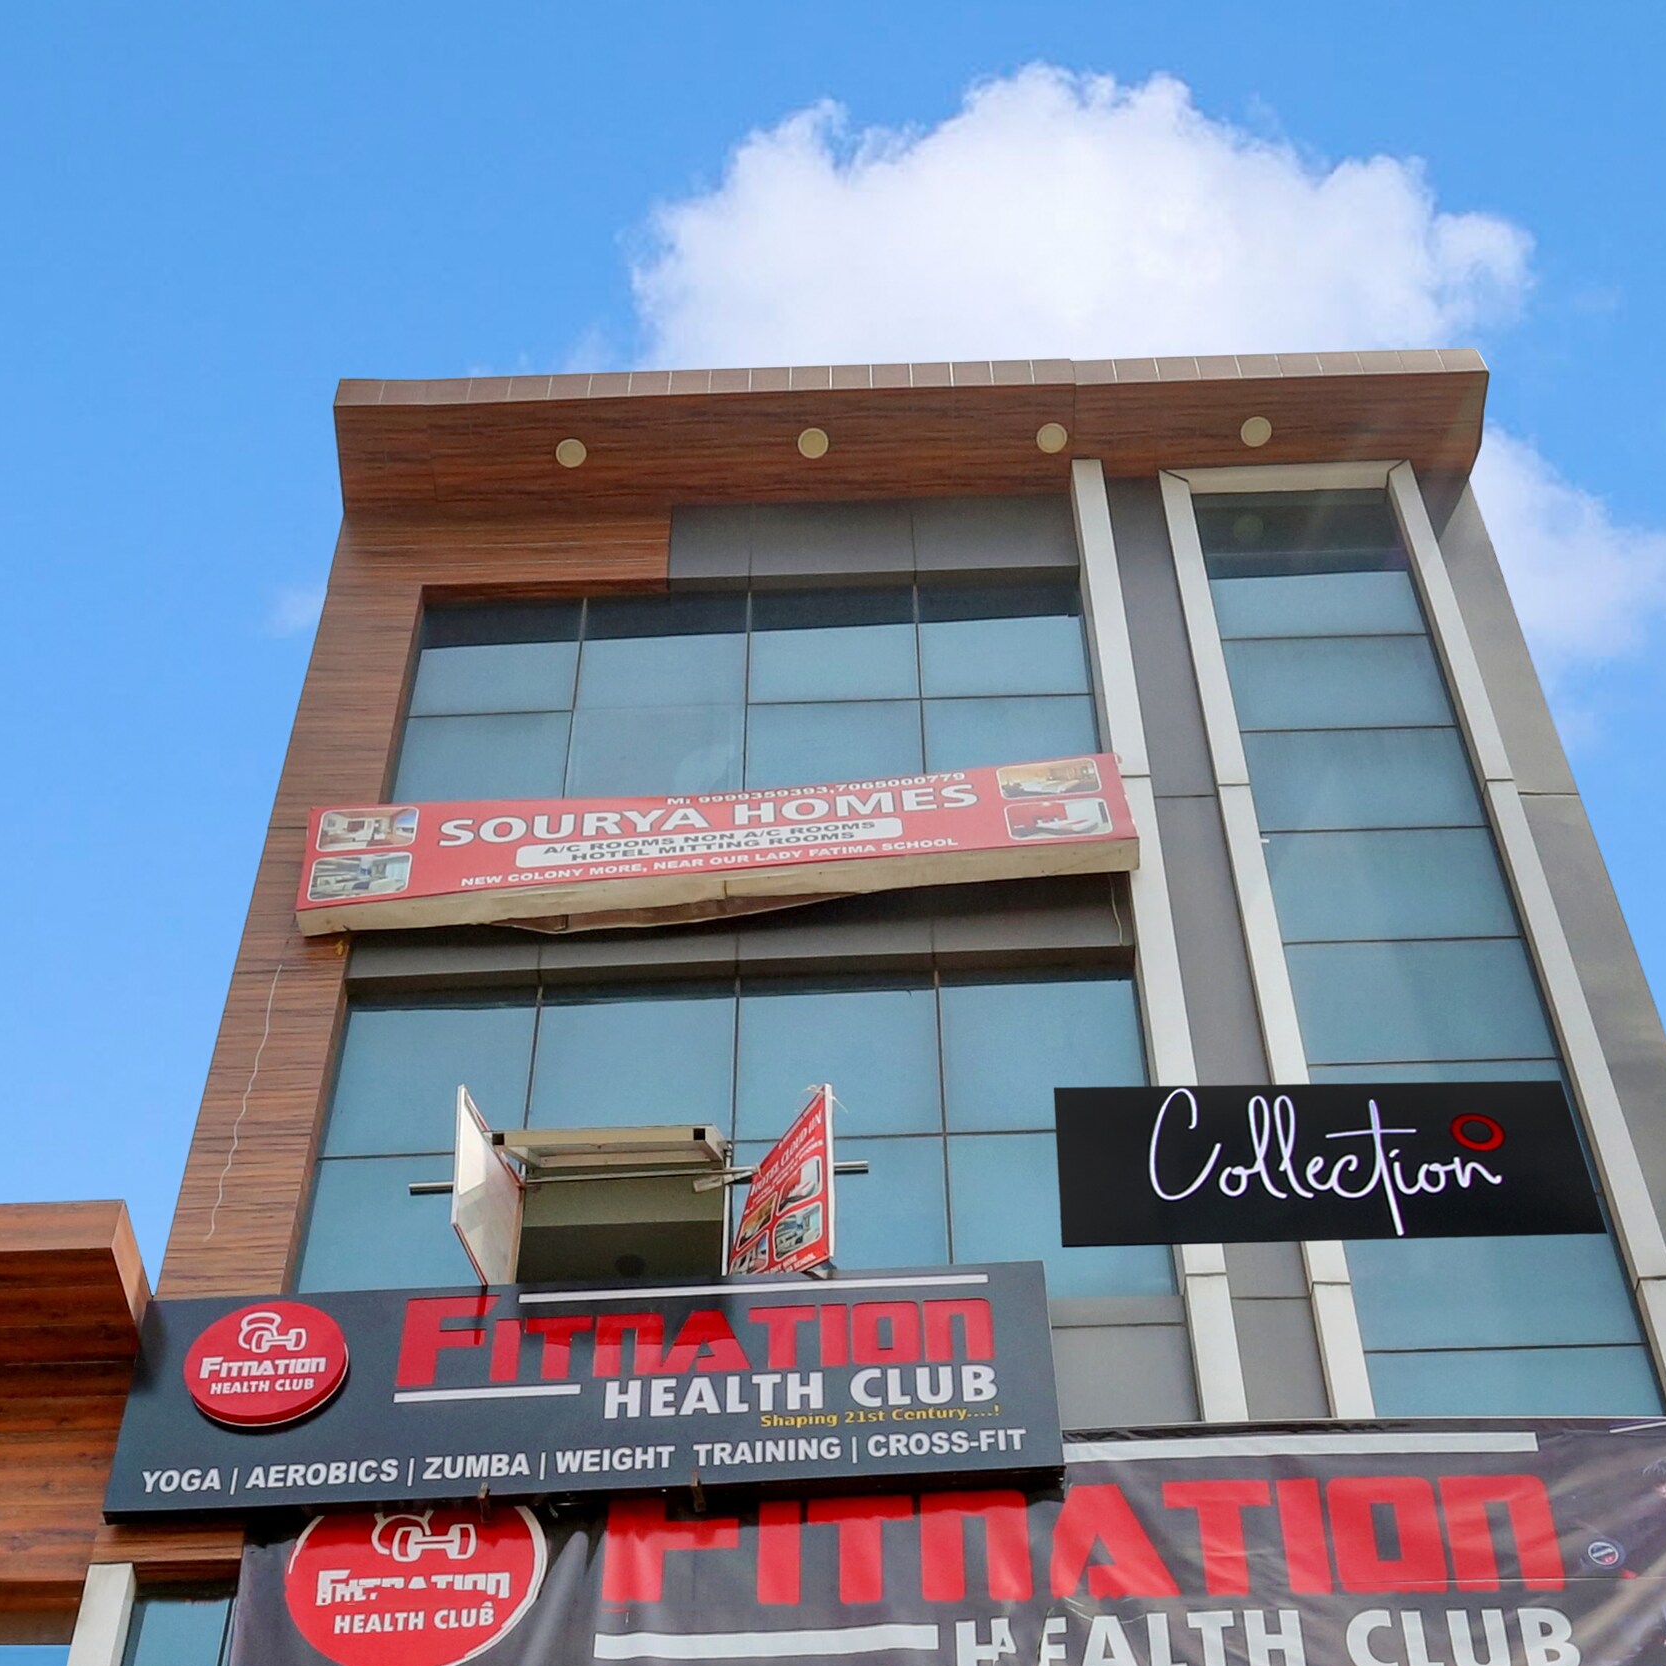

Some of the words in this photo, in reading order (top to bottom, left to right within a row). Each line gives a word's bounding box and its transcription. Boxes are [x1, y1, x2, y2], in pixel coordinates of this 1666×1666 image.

[438, 806, 711, 847] SOURYA
[732, 783, 978, 826] HOMES
[543, 842, 581, 855] A/C
[589, 836, 675, 851] ROOMS
[682, 832, 742, 846] NON
[744, 827, 782, 839] A/C
[789, 820, 876, 836] ROOMS
[571, 848, 651, 862] HOTEL
[657, 838, 761, 856] MITTING
[768, 830, 854, 847] ROOMS
[460, 874, 503, 887] NEW
[507, 867, 583, 883] COLONY
[653, 856, 704, 871] NEAR
[709, 853, 749, 865] OUR
[754, 849, 802, 862] LADY
[808, 843, 877, 858] FATIMA
[881, 837, 959, 852] SCHOOL
[1149, 1087, 1503, 1236] Collection
[209, 1380, 270, 1395] HEALTH
[275, 1376, 315, 1391] CLUB
[603, 1371, 823, 1419] HEALTH
[849, 1363, 998, 1408] CLUB
[760, 1412, 839, 1428] Shaping
[843, 1408, 886, 1423] 21st
[141, 1467, 222, 1494] YOGA
[244, 1457, 399, 1489] AEROBICS
[421, 1451, 531, 1481] ZUMBA
[555, 1444, 676, 1475] WEIGHT
[693, 1436, 842, 1467] TRAINING
[866, 1428, 1027, 1458] CROSS-FIT
[333, 1611, 426, 1635] HEALTH
[433, 1602, 496, 1629] CLUB
